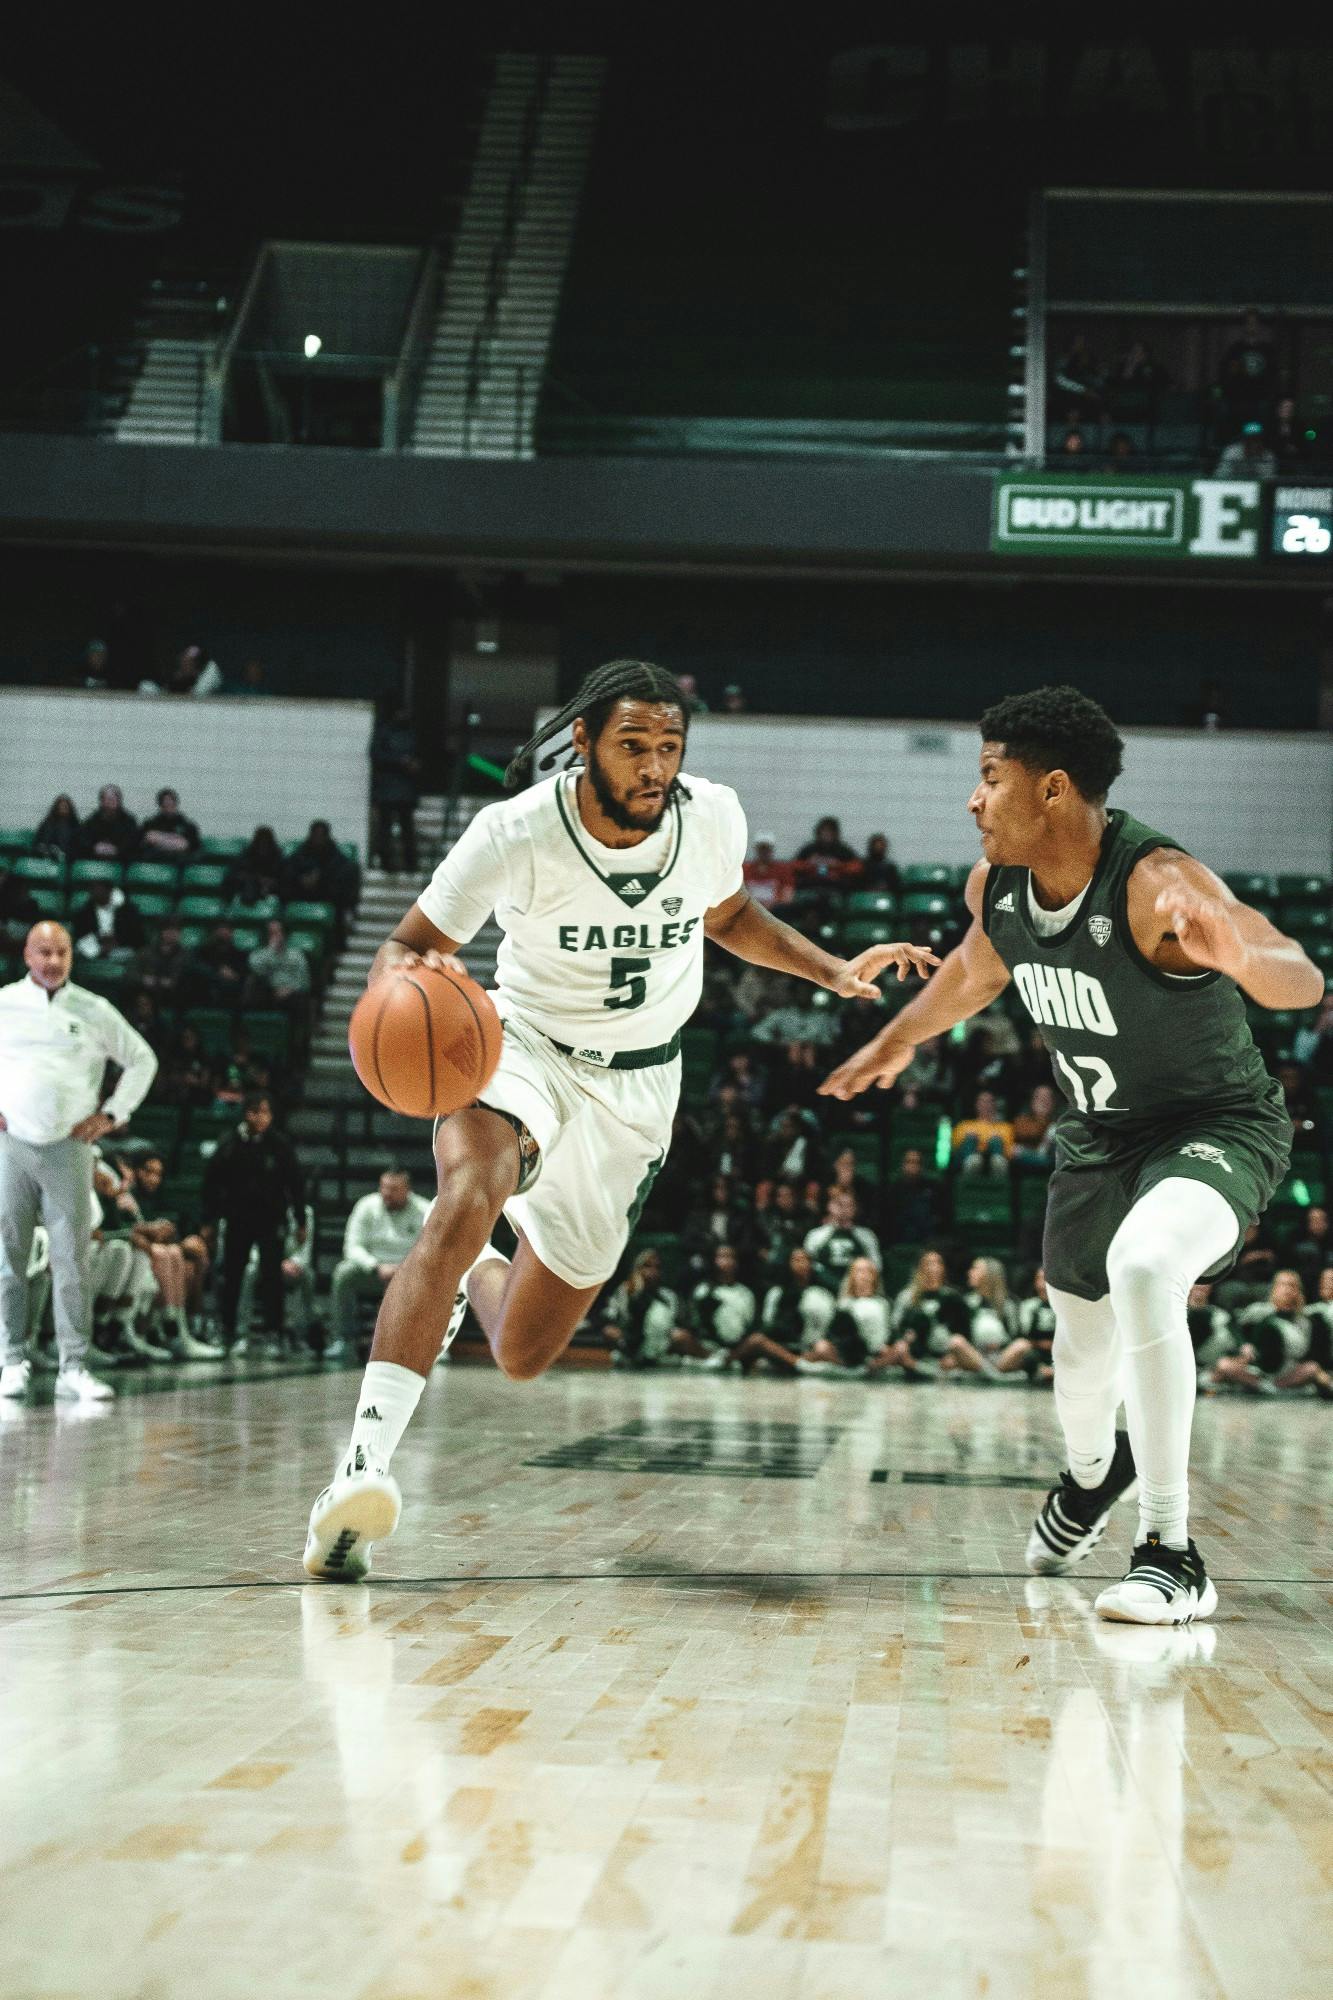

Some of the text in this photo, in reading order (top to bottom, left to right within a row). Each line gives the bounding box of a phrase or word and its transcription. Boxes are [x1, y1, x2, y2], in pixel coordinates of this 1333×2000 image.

[1010, 497, 1172, 531] BUD LIGHT
[1190, 479, 1260, 555] E
[559, 916, 700, 952] EAGLES
[603, 956, 651, 1010] 5
[1012, 962, 1119, 1037] OHIO
[1055, 1049, 1130, 1114] 12
